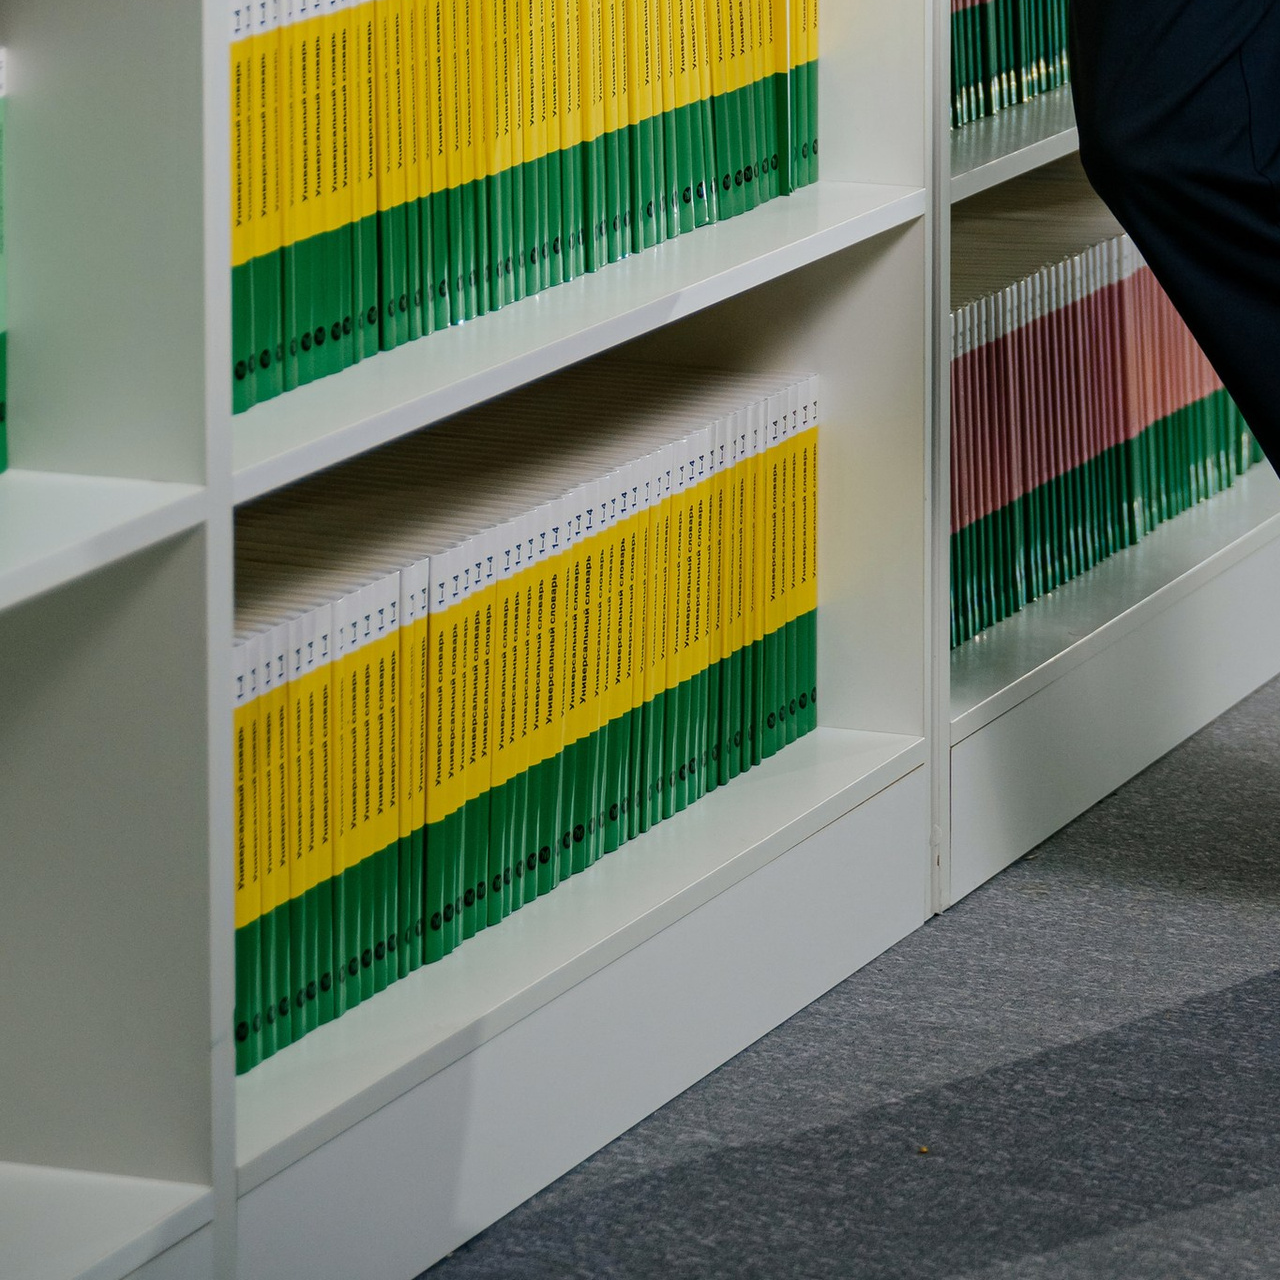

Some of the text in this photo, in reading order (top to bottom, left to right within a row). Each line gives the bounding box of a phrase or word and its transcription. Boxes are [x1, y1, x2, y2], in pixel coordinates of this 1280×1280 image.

[687, 505, 695, 553] словарь
[696, 499, 704, 547] словарь
[583, 555, 593, 605] словарь
[618, 538, 626, 587] словарь
[693, 550, 702, 643] Универсальный
[484, 604, 493, 655] словарь
[536, 579, 545, 630] словарь
[549, 574, 558, 624] словарь
[684, 556, 693, 648] Универсальный
[437, 631, 445, 683] словарь
[579, 608, 591, 704] Универсальный
[615, 590, 625, 685] Универсальный
[481, 658, 491, 758] Универсальный
[533, 633, 543, 731] Универсальный
[545, 627, 557, 725] Универсальный
[435, 686, 444, 787] Универсальный
